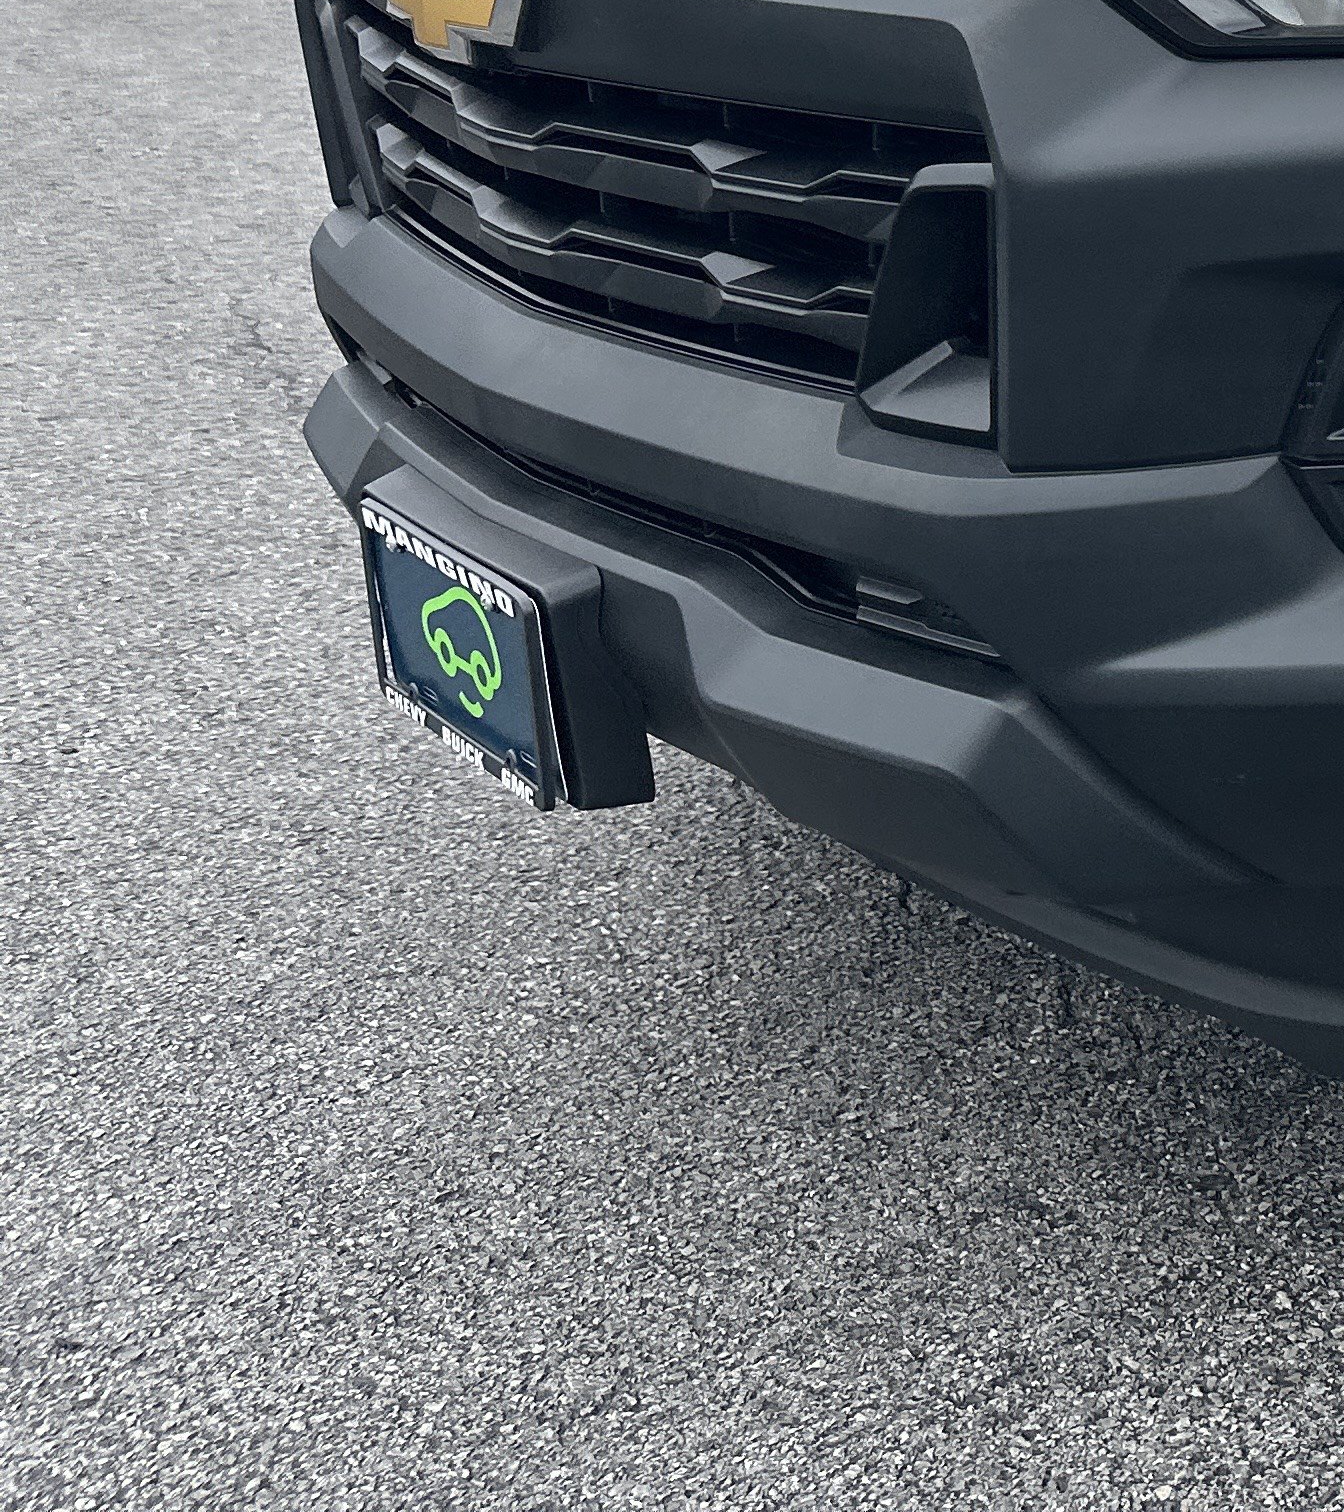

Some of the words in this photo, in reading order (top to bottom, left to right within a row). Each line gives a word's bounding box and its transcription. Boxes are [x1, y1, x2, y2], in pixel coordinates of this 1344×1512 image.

[361, 506, 515, 619] MANGINO
[385, 685, 427, 727] CHEVY
[441, 725, 486, 772] BUICK
[501, 767, 535, 807] GMC
